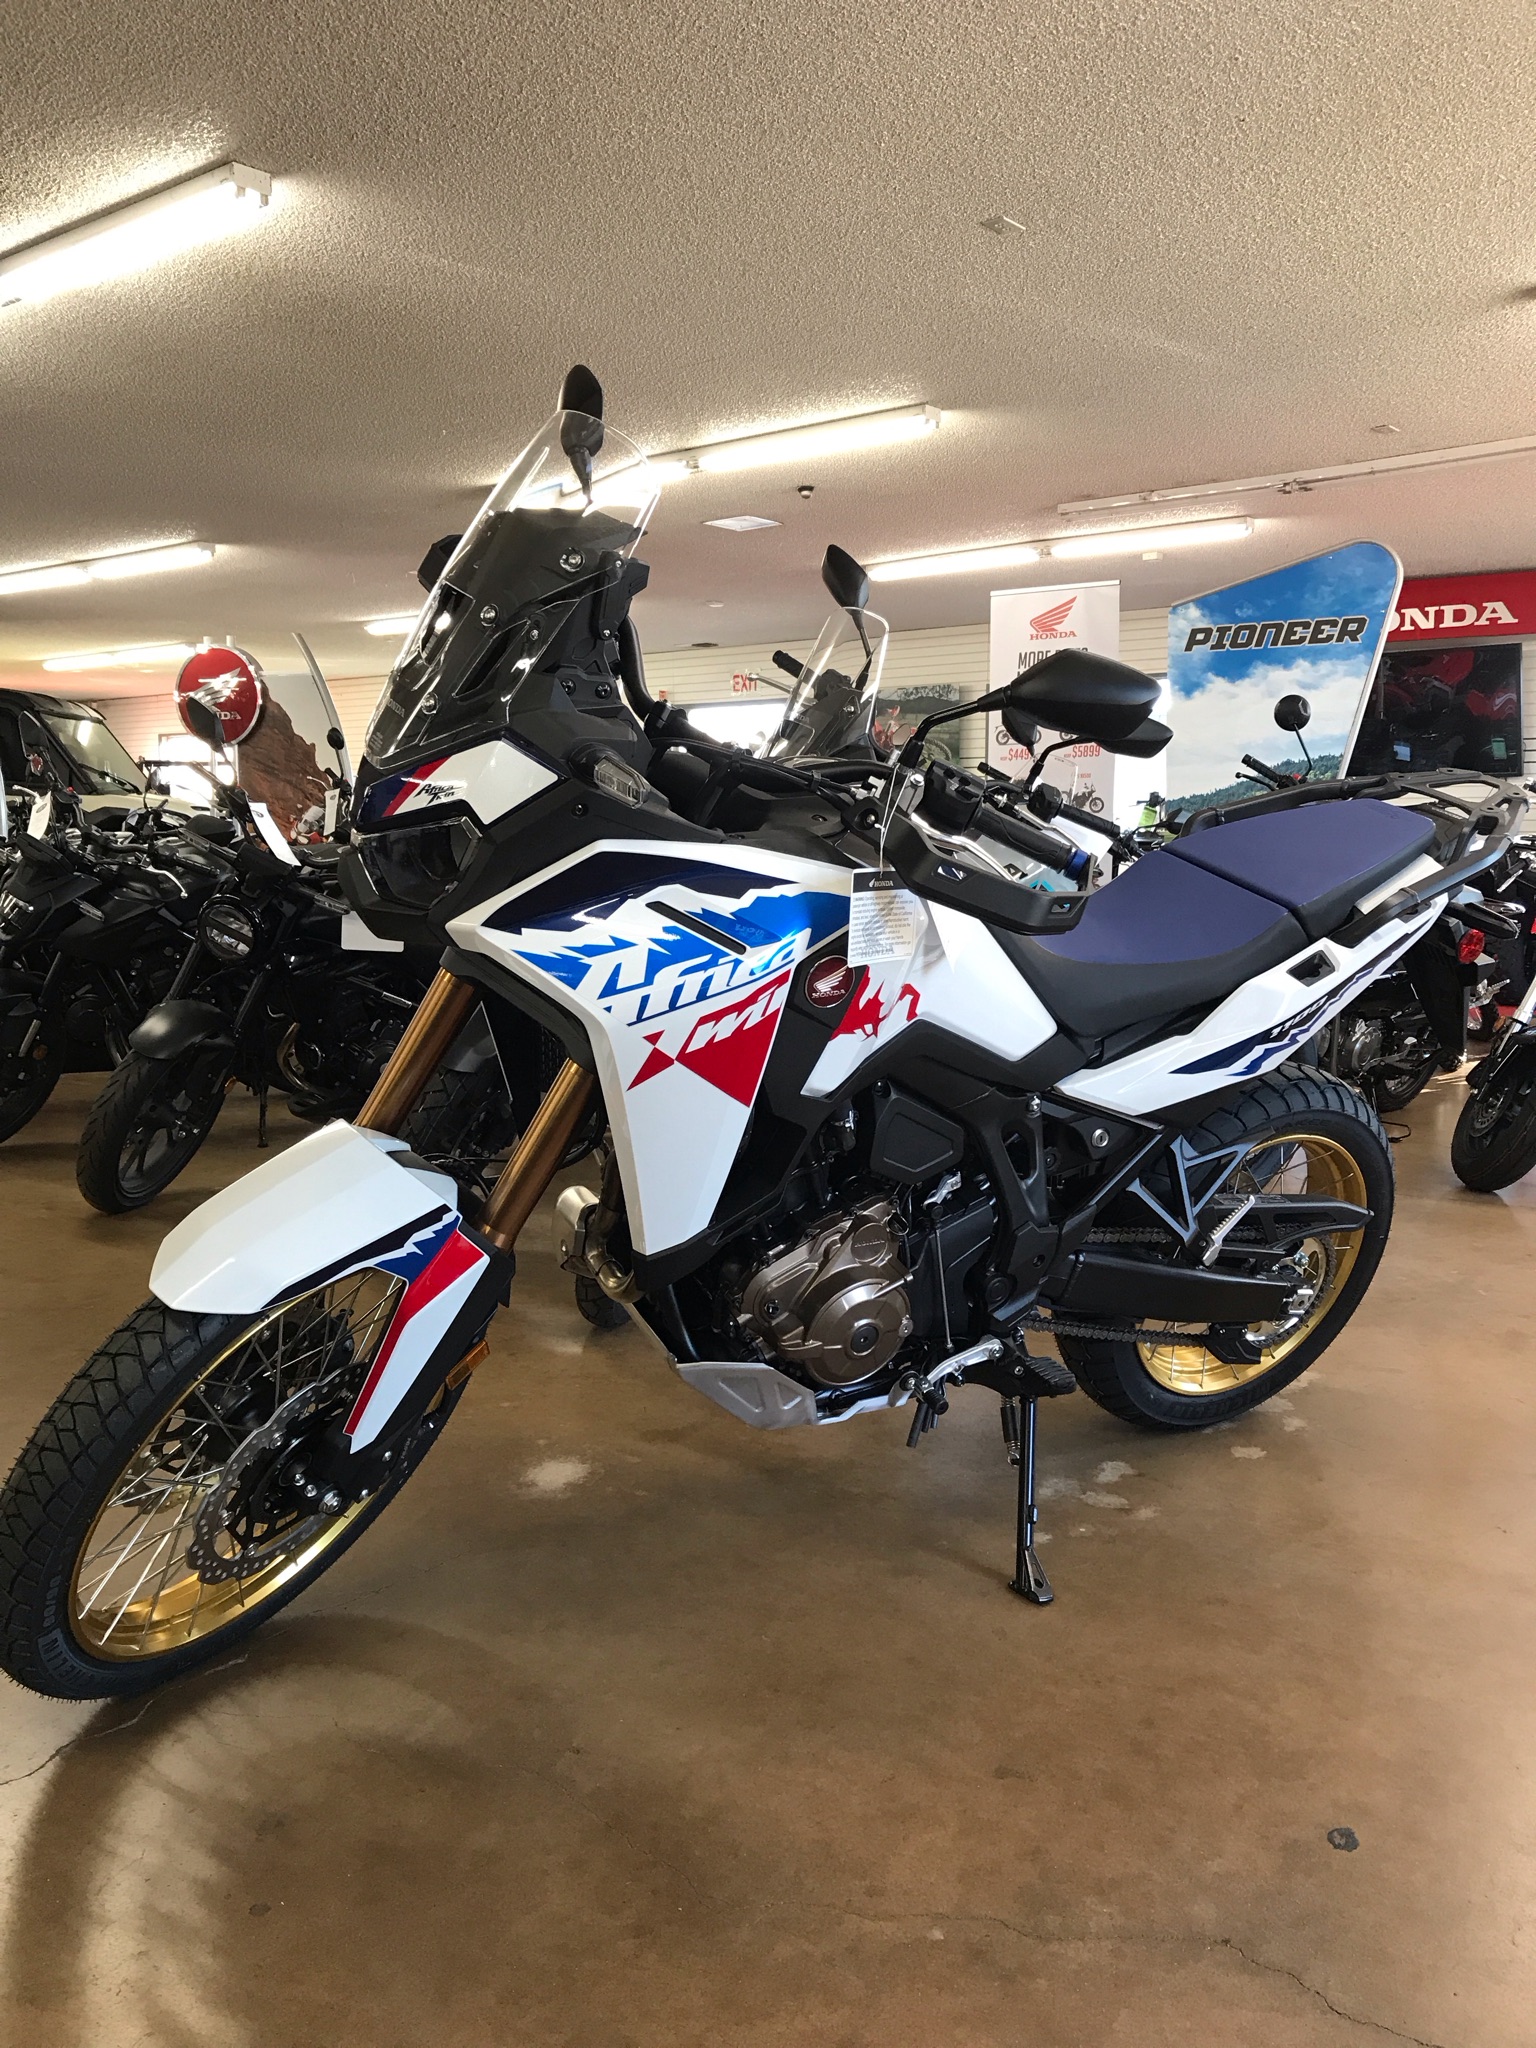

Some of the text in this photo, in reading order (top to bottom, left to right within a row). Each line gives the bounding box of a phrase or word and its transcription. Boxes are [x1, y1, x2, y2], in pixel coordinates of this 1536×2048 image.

[1387, 602, 1518, 632] NDA
[1029, 630, 1077, 640] HONDA
[1184, 615, 1369, 653] PIONEER
[387, 698, 405, 718] ONDA
[1008, 748, 1032, 761] $449
[1072, 744, 1101, 758] $5899
[413, 783, 462, 799] Africa
[575, 932, 806, 1026] Africa
[812, 989, 846, 998] HONDA
[1269, 995, 1329, 1039] 1100
